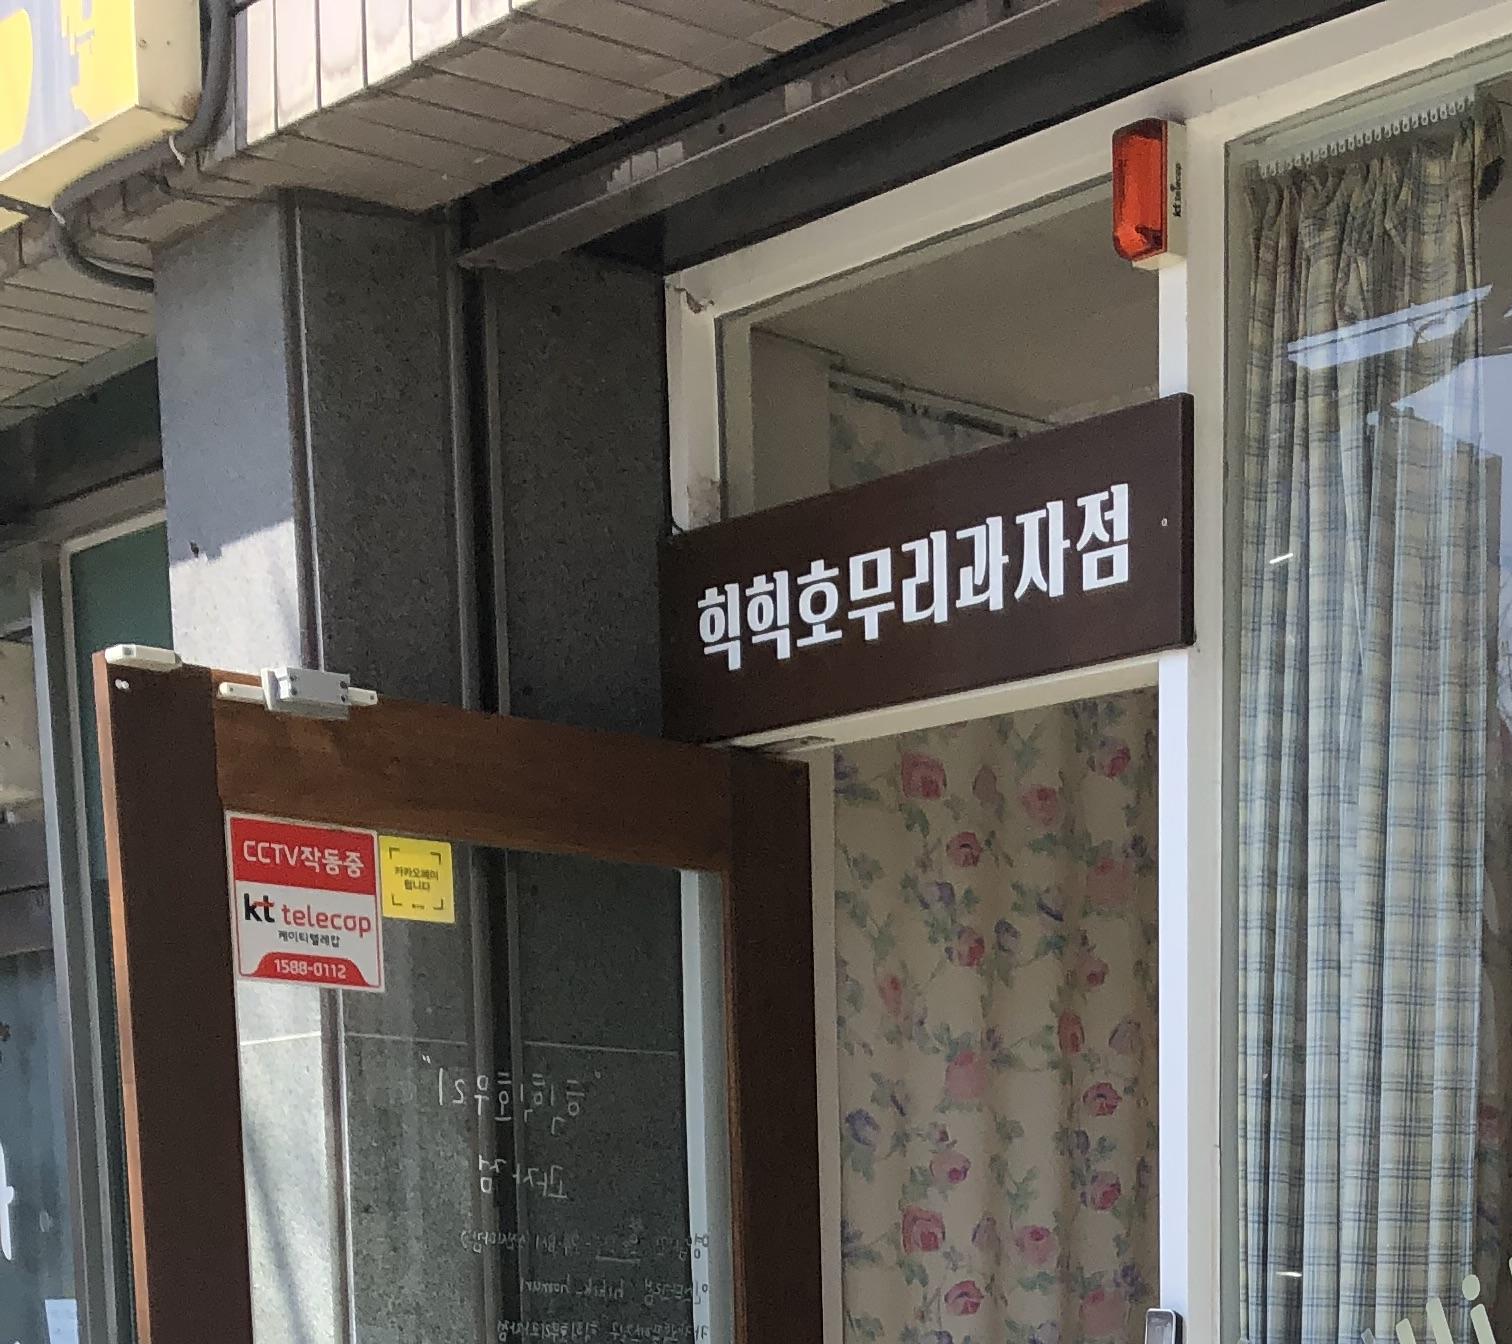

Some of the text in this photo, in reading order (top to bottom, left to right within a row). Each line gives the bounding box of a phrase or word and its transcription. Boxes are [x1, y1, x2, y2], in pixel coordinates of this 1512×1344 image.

[697, 483, 1129, 671] 힉힉호무리과자점
[244, 893, 371, 938] kt telecop
[273, 959, 346, 979] 1588-0112
